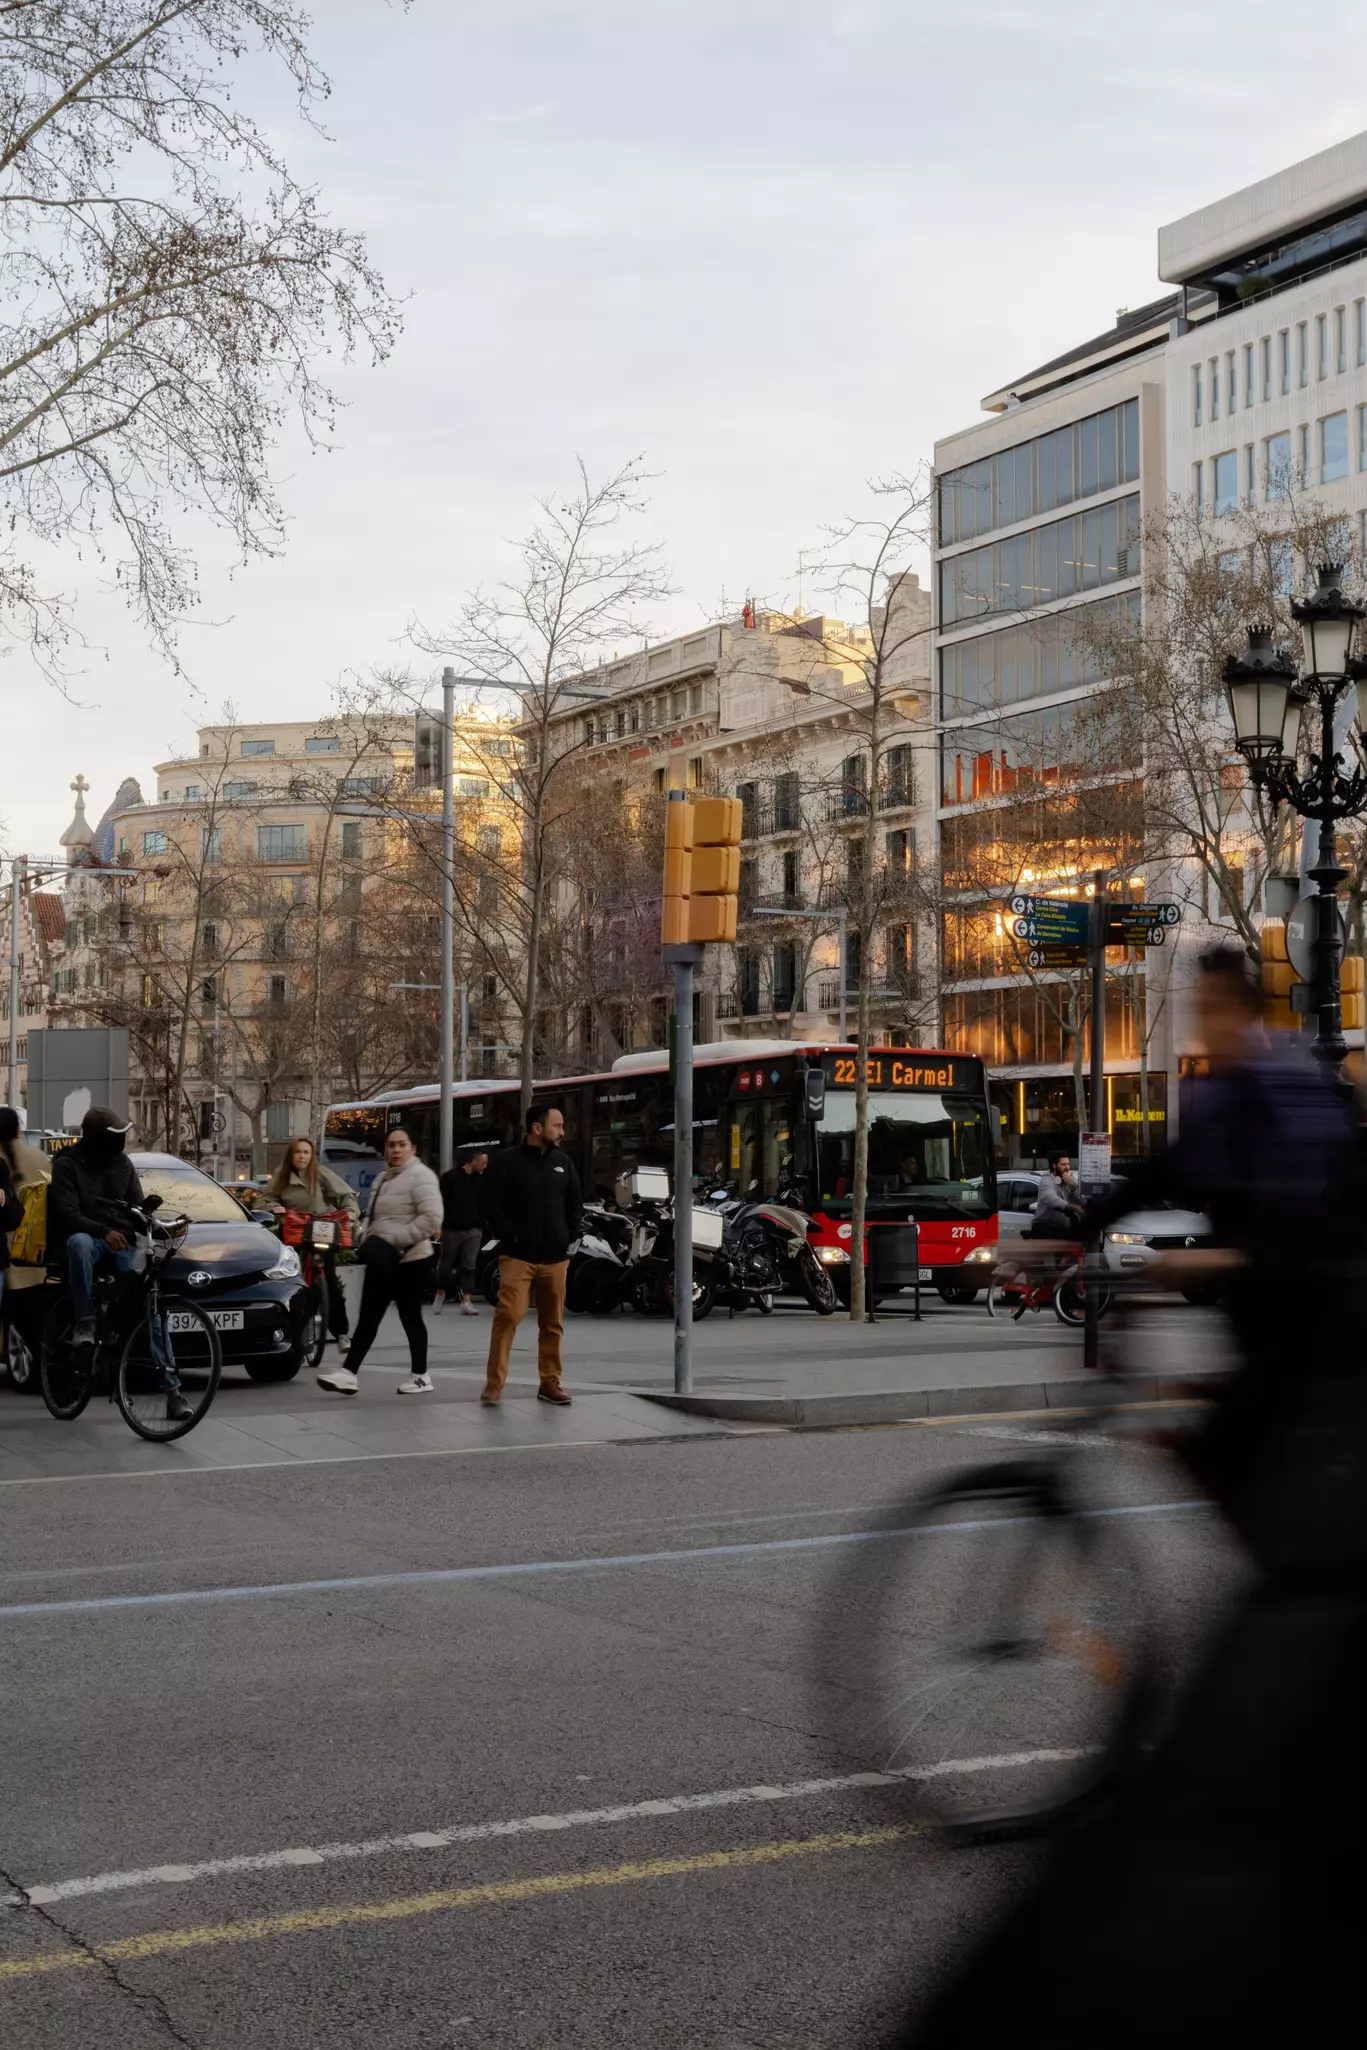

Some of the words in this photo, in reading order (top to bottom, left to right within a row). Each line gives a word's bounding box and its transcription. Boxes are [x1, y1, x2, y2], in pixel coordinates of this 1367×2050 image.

[835, 1060, 856, 1082] 22
[866, 1061, 881, 1083] El
[893, 1062, 953, 1086] Carmel
[952, 1227, 976, 1238] 2716
[213, 1313, 240, 1328] KPF
